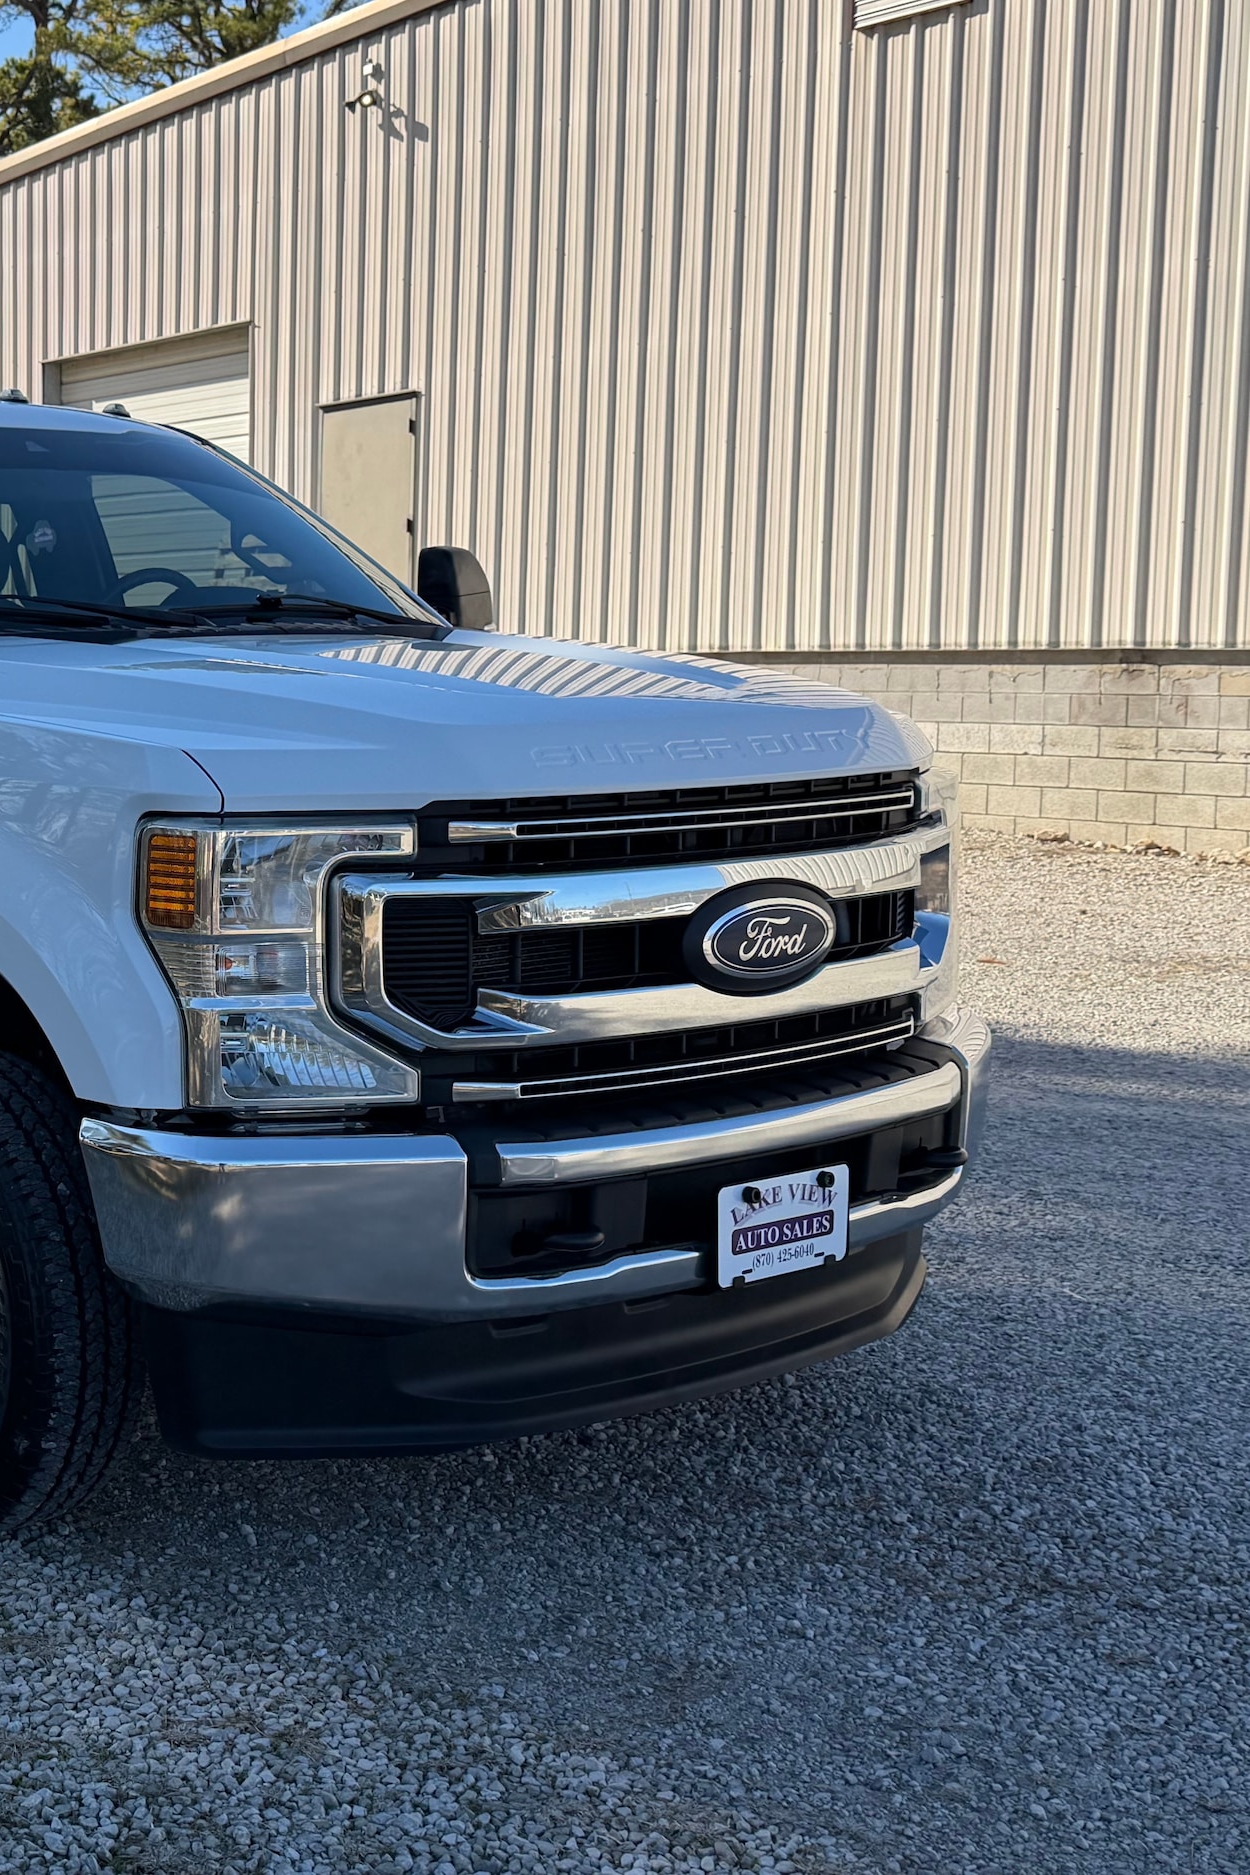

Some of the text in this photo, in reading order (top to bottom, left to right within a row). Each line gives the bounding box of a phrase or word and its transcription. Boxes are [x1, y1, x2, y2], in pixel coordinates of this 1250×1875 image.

[530, 737, 736, 768] SUPER
[739, 916, 807, 961] Ford
[730, 1183, 837, 1226] LAKE VIEW
[735, 1214, 831, 1252] AUTO SALES
[752, 1242, 815, 1271] (870) 425-6040
